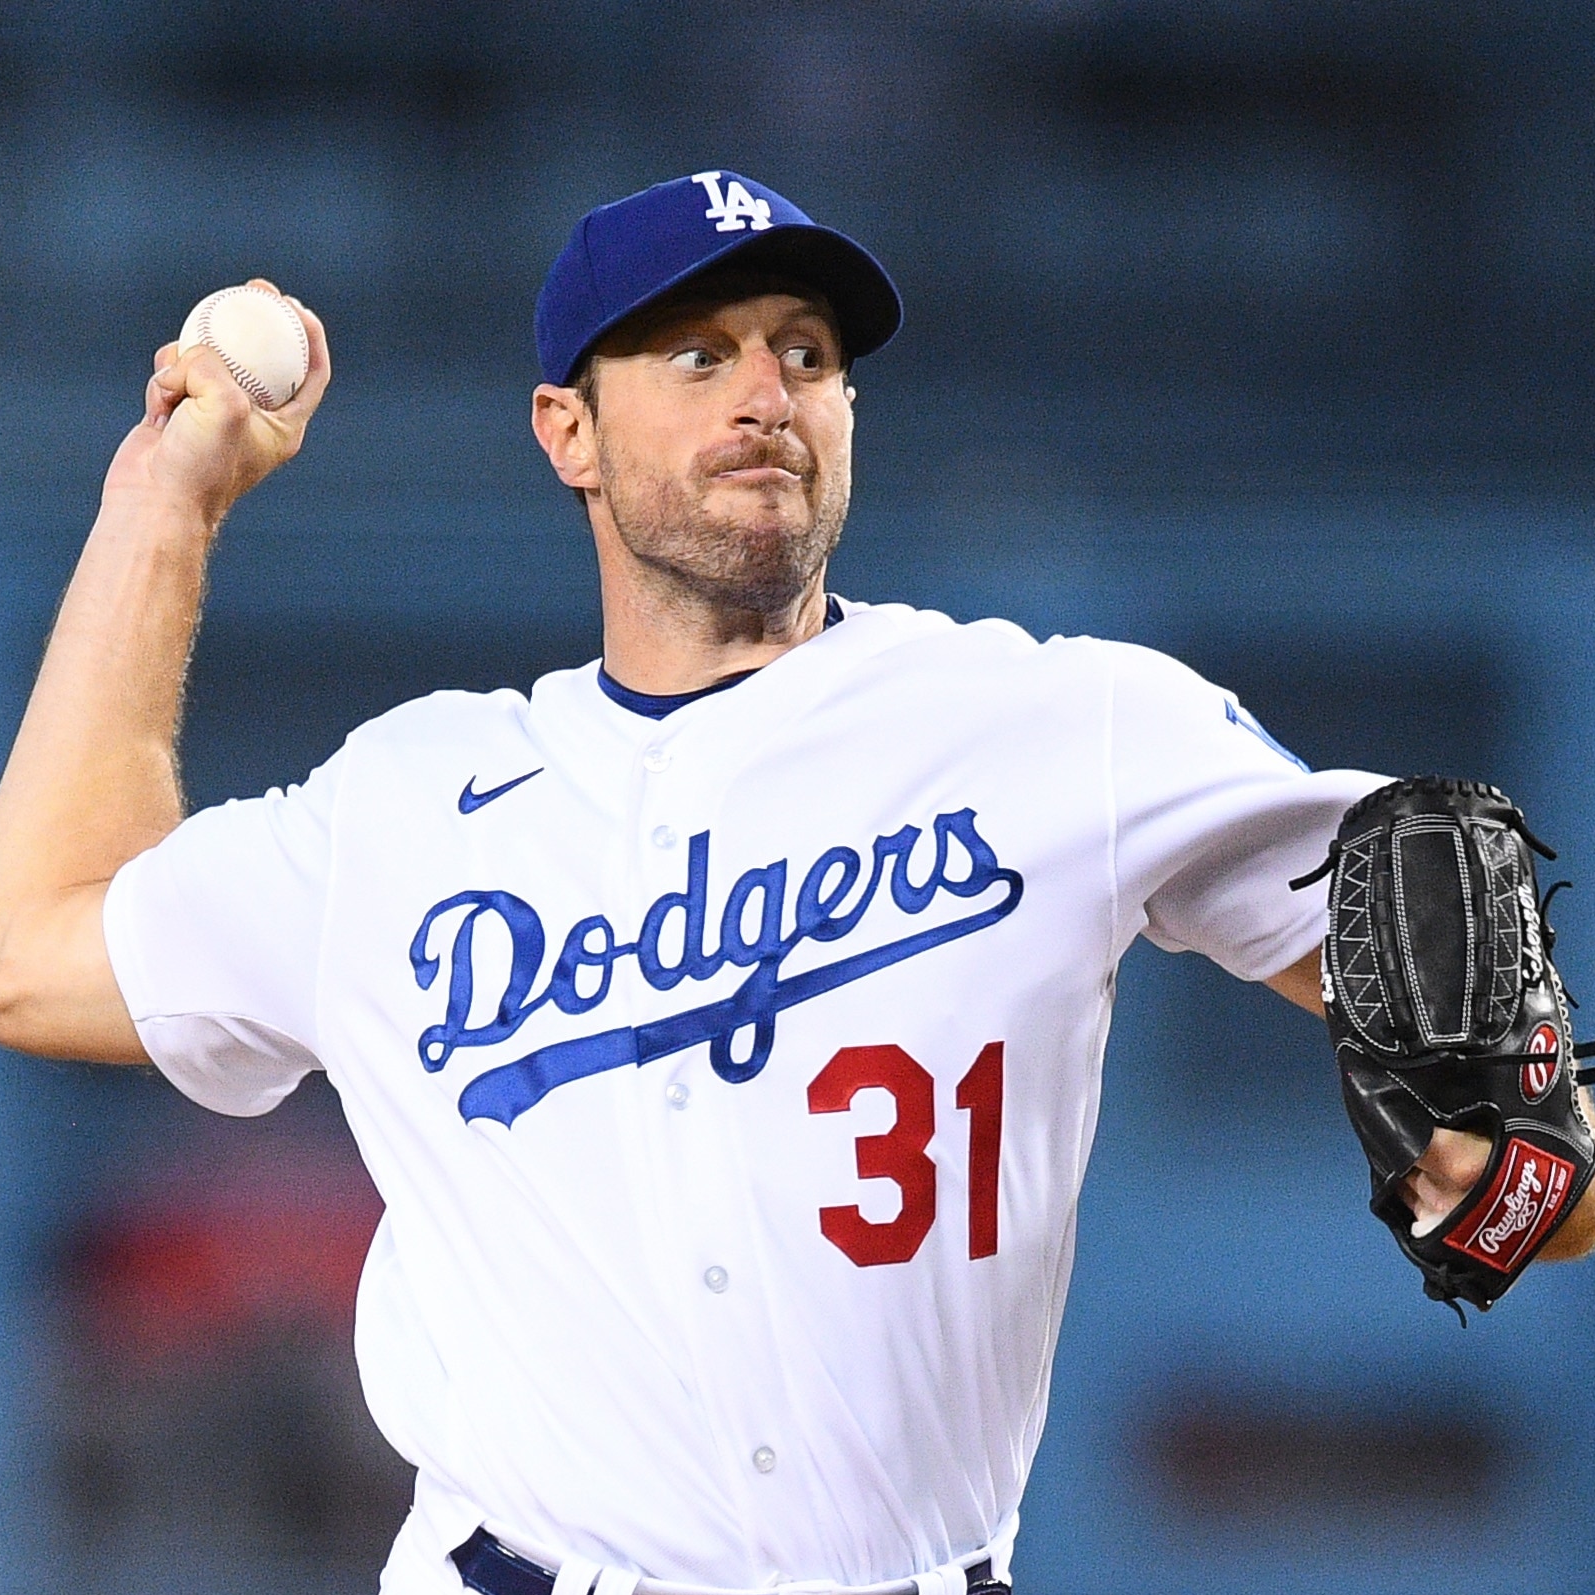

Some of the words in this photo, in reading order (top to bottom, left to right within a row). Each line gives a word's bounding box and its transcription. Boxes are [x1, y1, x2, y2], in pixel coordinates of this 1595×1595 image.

[691, 171, 773, 232] LA
[409, 807, 1024, 1084] Dodgers
[807, 1041, 1005, 1268] 31
[1478, 1158, 1542, 1254] Rawlings
